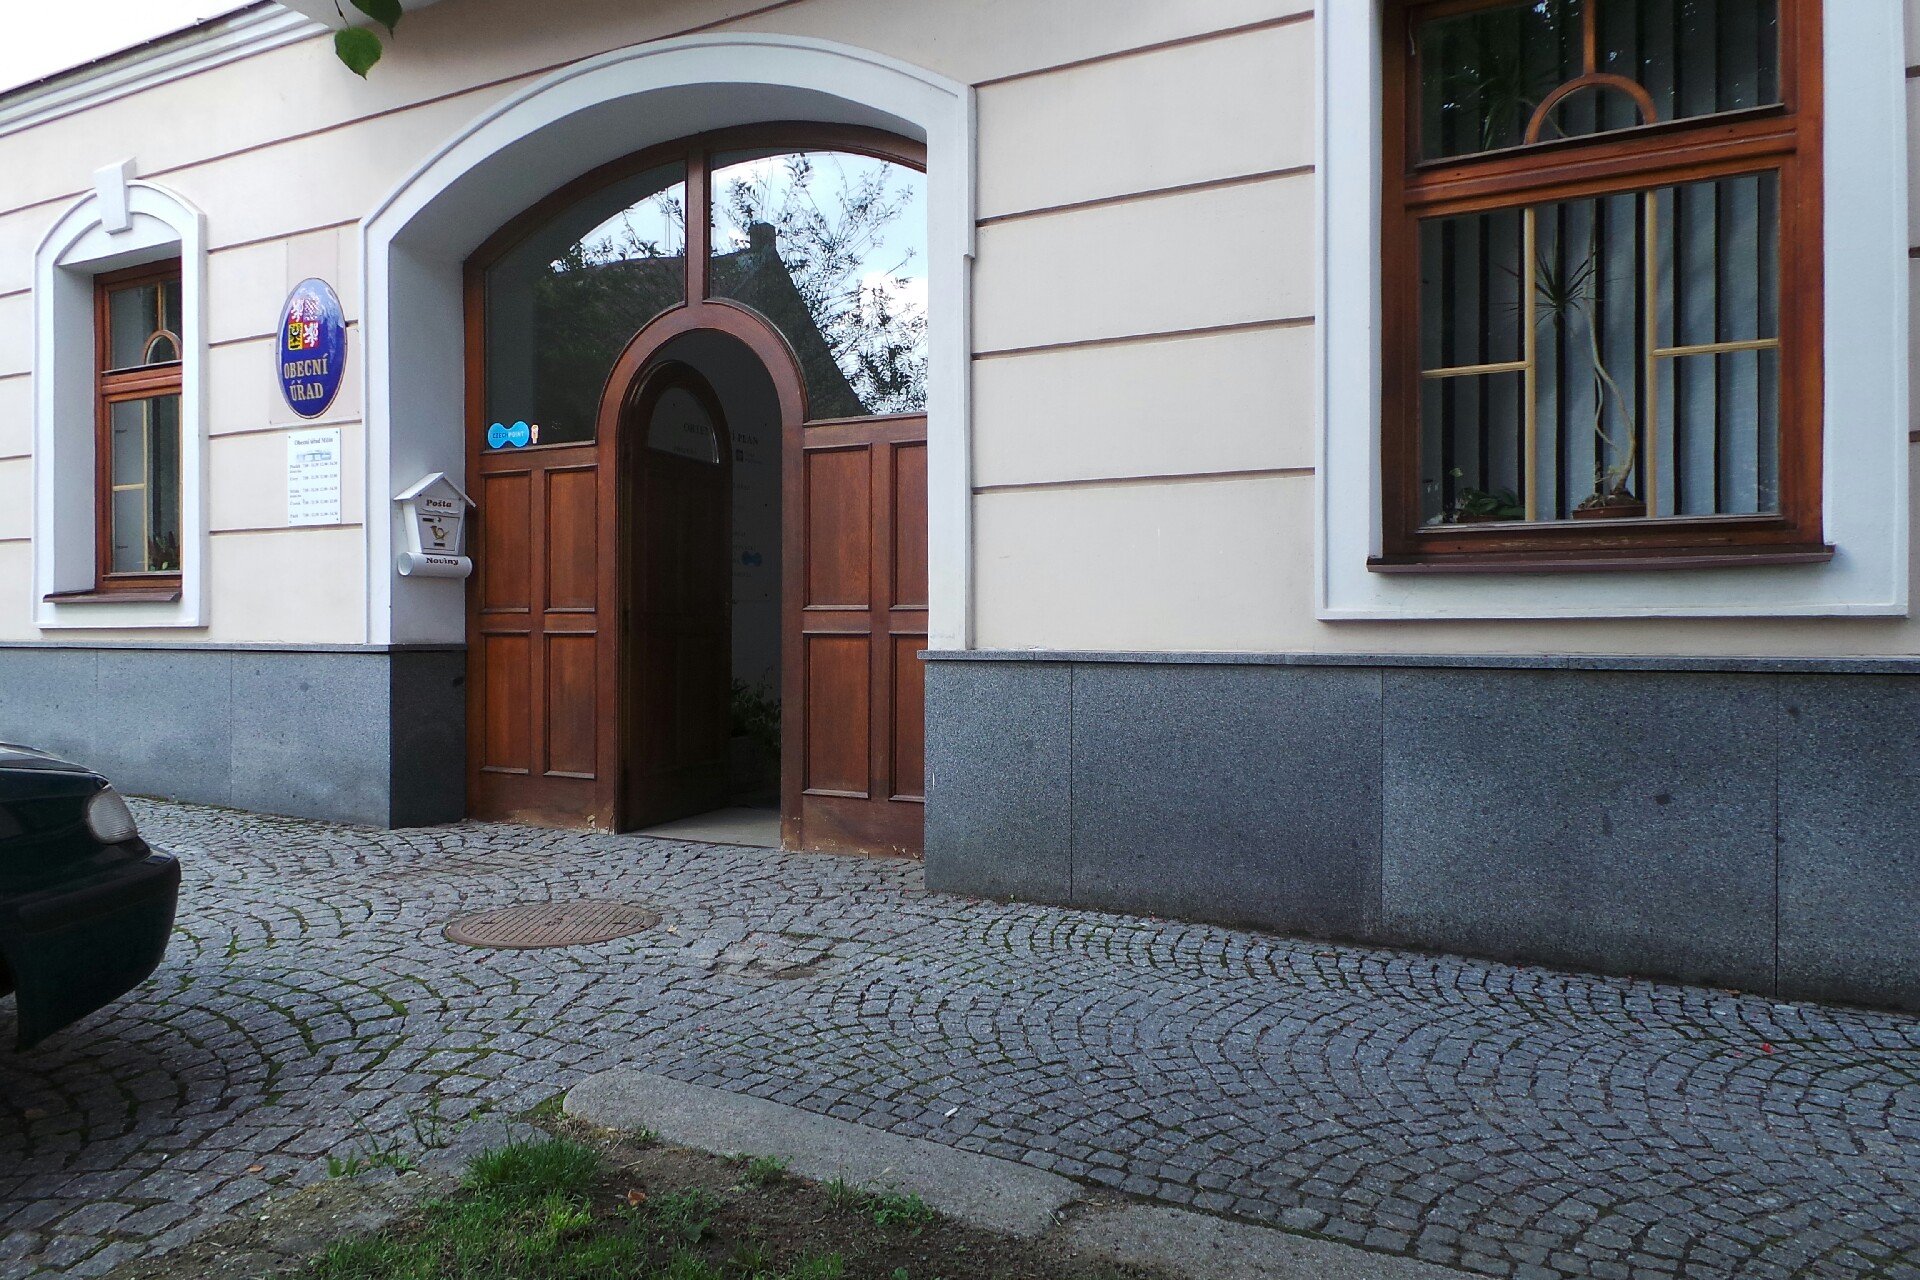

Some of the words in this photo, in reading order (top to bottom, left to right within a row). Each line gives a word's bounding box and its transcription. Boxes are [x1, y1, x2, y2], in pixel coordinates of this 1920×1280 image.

[284, 353, 328, 379] OBECNÍ
[289, 380, 324, 401] ÚŘAD
[426, 499, 452, 508] Pošta
[425, 557, 459, 566] Noviny
